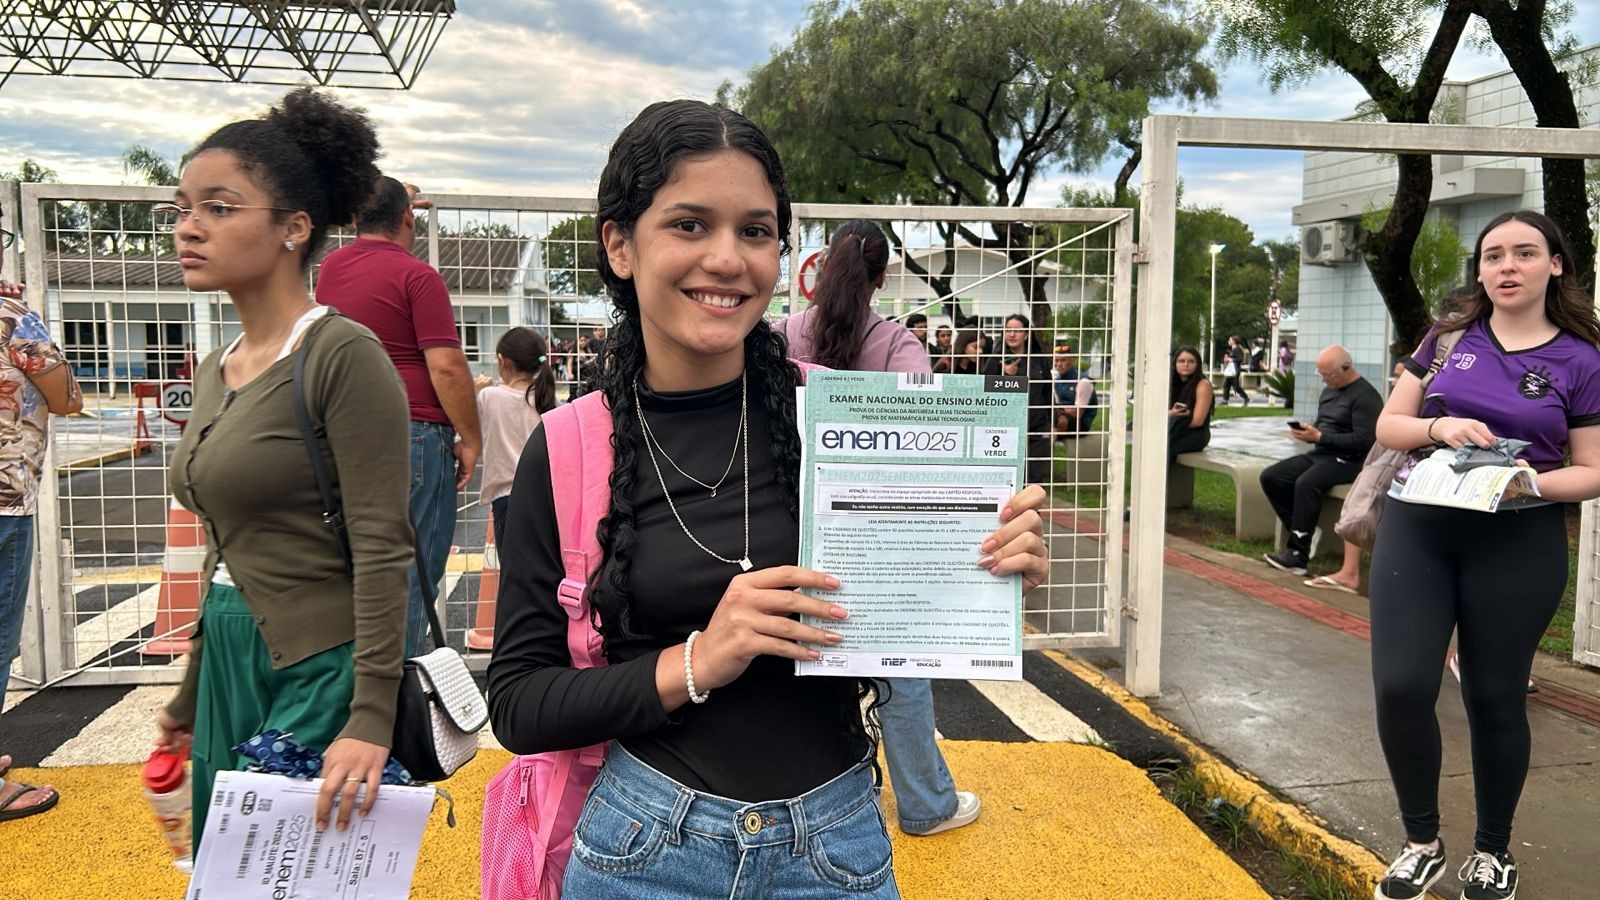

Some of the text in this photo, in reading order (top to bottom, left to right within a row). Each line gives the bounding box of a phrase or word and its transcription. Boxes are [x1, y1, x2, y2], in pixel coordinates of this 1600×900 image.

[168, 391, 192, 407] 20
[830, 395, 863, 403] EXAME
[866, 396, 916, 404] NACIONAL
[975, 396, 1008, 406] MÉDIO
[822, 430, 958, 451] enem2025
[992, 436, 1000, 447] 8
[272, 814, 306, 900] enem2025
[349, 863, 361, 885] Sala:
[355, 848, 364, 860] B7
